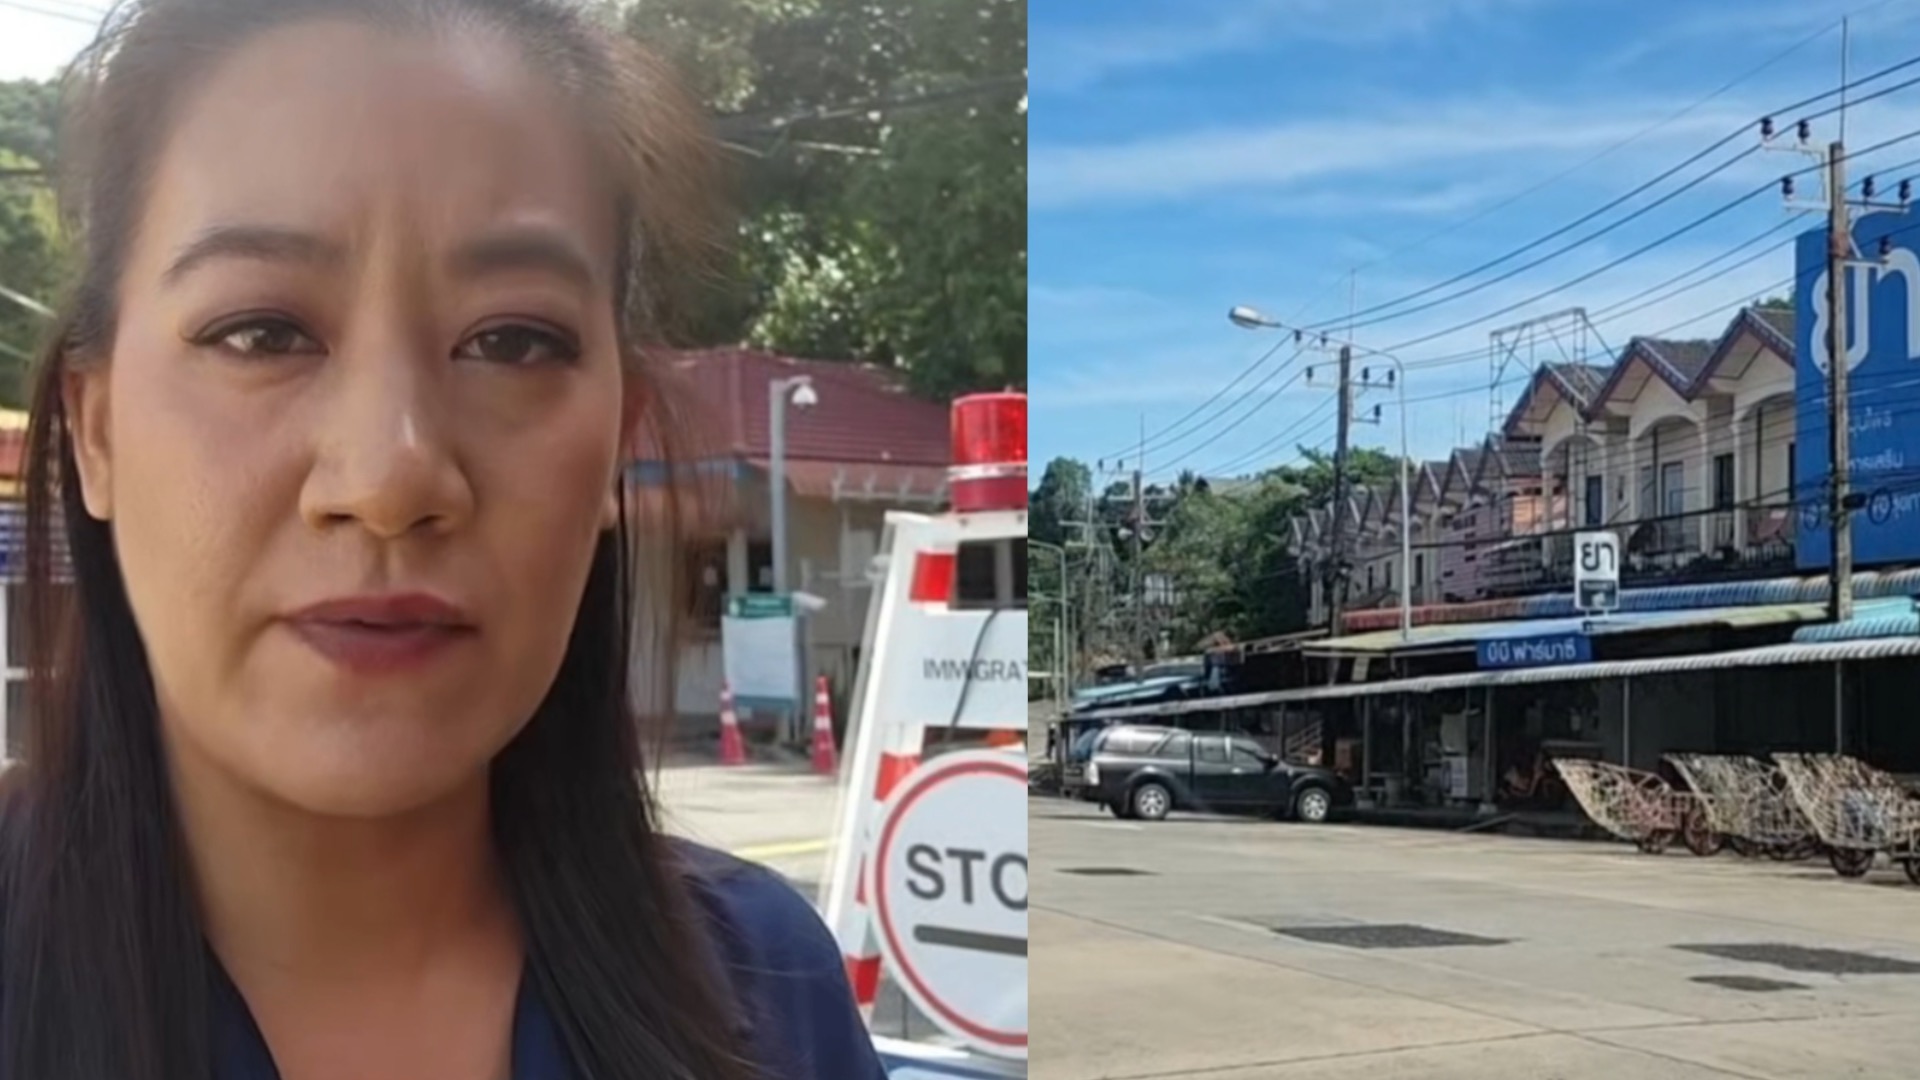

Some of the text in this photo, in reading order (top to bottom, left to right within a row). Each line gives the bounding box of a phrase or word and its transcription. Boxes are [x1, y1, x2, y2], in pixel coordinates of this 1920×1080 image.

[1811, 247, 1920, 374] ยา
[1581, 542, 1615, 572] ยา
[905, 843, 1027, 911] STO
